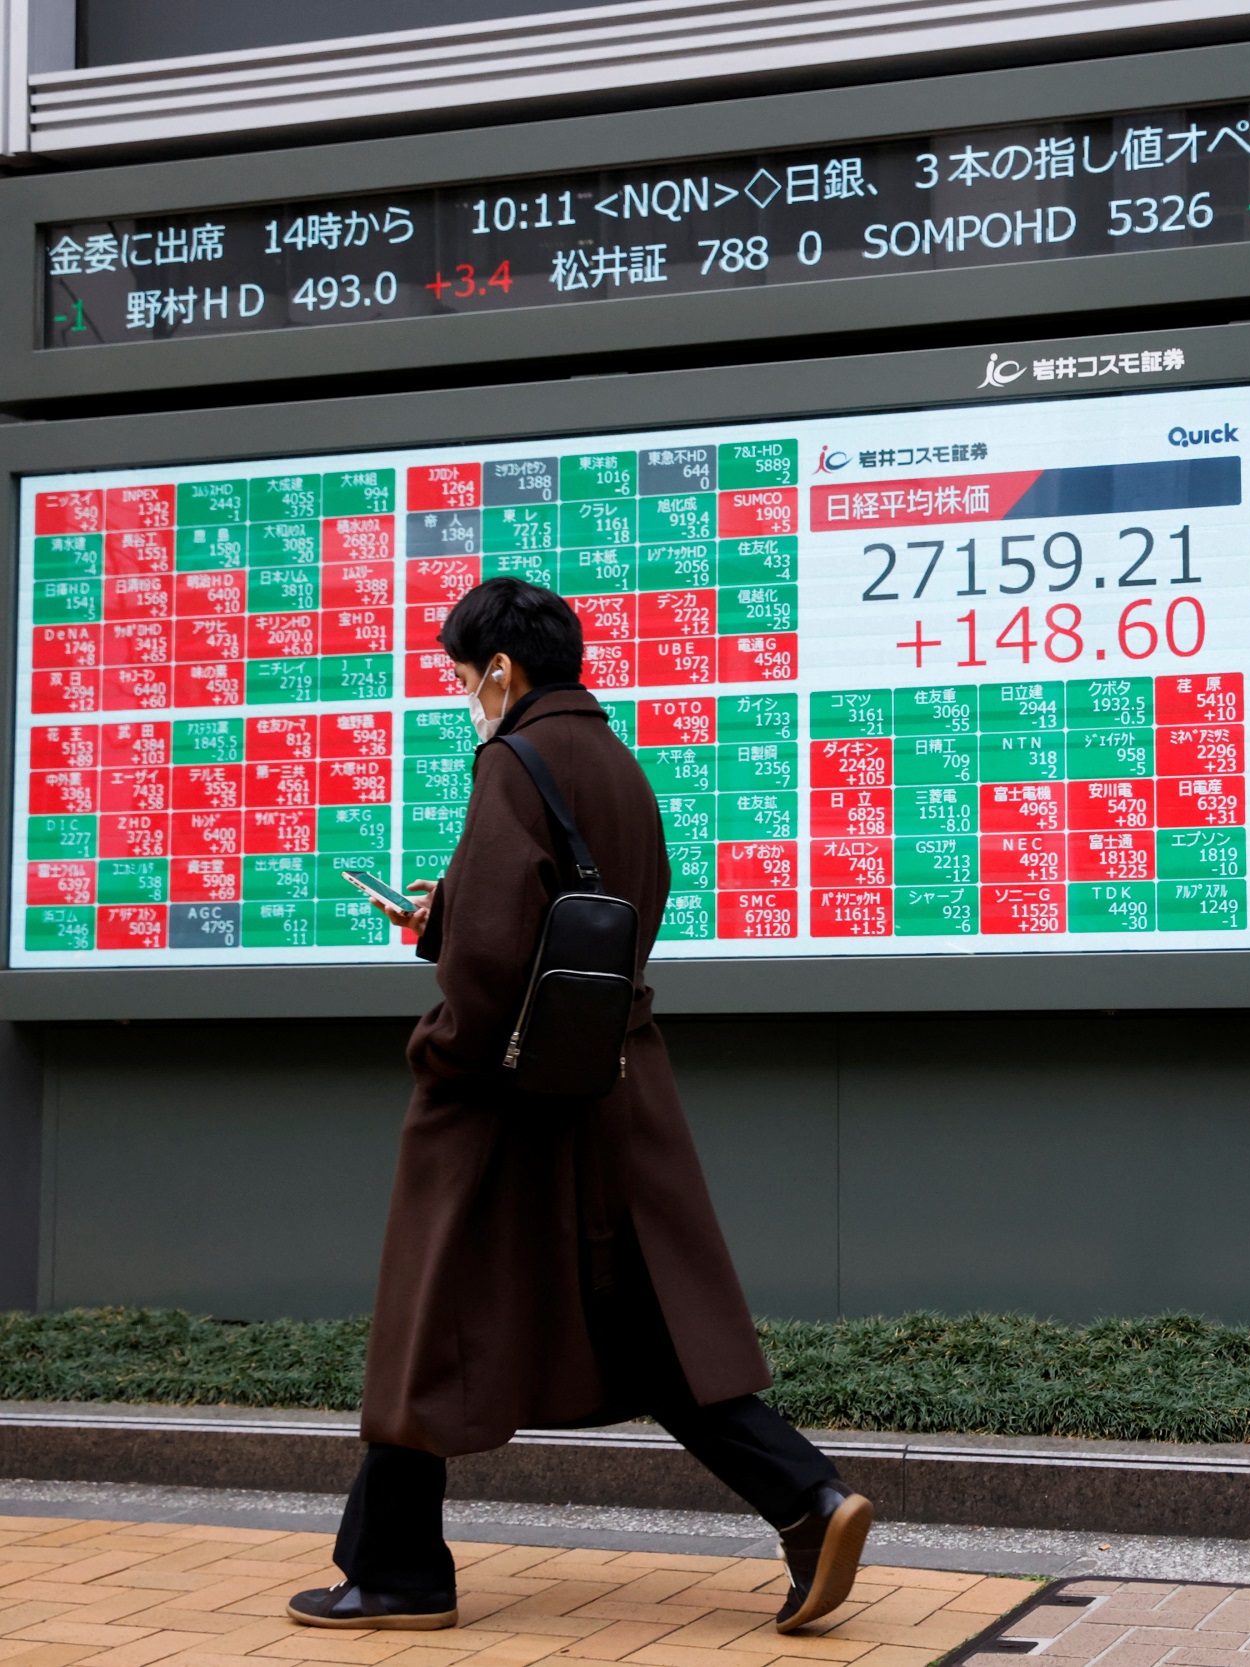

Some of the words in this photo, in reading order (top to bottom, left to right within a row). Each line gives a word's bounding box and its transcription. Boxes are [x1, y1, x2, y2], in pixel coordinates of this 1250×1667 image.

[50, 223, 225, 275] 金委に出席
[265, 208, 413, 253] 14時から
[473, 191, 575, 233] 10:11
[56, 301, 86, 330] -1
[293, 272, 397, 311] 493.0
[426, 261, 513, 299] +3.4
[550, 244, 667, 291] 松井証
[698, 236, 768, 275] 788
[798, 231, 821, 265] 0
[862, 206, 1076, 260] SOMPOHD
[1108, 192, 1213, 236] 5326
[1033, 349, 1185, 381] 岩井コスモ証券
[647, 449, 707, 466] 東急不HD
[733, 443, 783, 458] 7&I-HD
[859, 442, 988, 468] 岩井コスモ証券
[682, 463, 709, 478] 644
[755, 457, 791, 476] 5889
[700, 476, 709, 490] 0
[776, 474, 790, 484] -2
[733, 491, 782, 507] SUMCO
[827, 485, 990, 521] 日経平均株価
[74, 505, 98, 520] 540
[138, 501, 169, 515] 1342
[579, 503, 618, 518] クラレ
[756, 505, 791, 521] 1900
[79, 521, 90, 531] +2
[144, 513, 169, 527] +15
[596, 516, 629, 532] 1161
[770, 518, 791, 533] +5
[607, 529, 630, 544] -18
[862, 525, 1202, 601] 27159.21
[281, 582, 313, 597] 3810
[292, 595, 313, 609] -10
[657, 592, 696, 609] デンカ
[674, 607, 709, 622] 2722
[680, 620, 709, 635] +12
[896, 597, 1206, 668] +148.60
[206, 633, 239, 647] 4731
[267, 628, 313, 644] 2070.0
[221, 646, 239, 659] +8
[282, 641, 313, 655] +6.0
[279, 674, 312, 689] 2719
[290, 688, 311, 701] -21
[831, 693, 871, 707] コマツ
[737, 697, 778, 712] ガイシ
[755, 711, 790, 726] 1733
[848, 707, 884, 722] 3161
[775, 725, 790, 739] -6
[860, 721, 884, 735] -21
[823, 741, 878, 758] ダイキン
[839, 757, 885, 772] 22420
[846, 770, 885, 785] +105
[133, 783, 164, 797] 7433
[993, 785, 1051, 802] 富士電機
[138, 796, 164, 810] +58
[1019, 801, 1058, 816] 4965
[1036, 814, 1058, 829] +5
[359, 822, 384, 840] 619
[1171, 830, 1230, 847] エプソン
[371, 838, 384, 849] -3
[731, 843, 785, 860] しずおか
[1199, 847, 1238, 862] 1819
[763, 859, 790, 873] 928
[1211, 861, 1238, 876] -10
[770, 873, 790, 887] +2
[909, 887, 965, 904] シャープ
[995, 888, 1050, 903] ソニーG
[942, 904, 970, 919] 923
[1011, 903, 1059, 918] 11525
[955, 919, 971, 932] -6
[1018, 917, 1059, 932] +290
